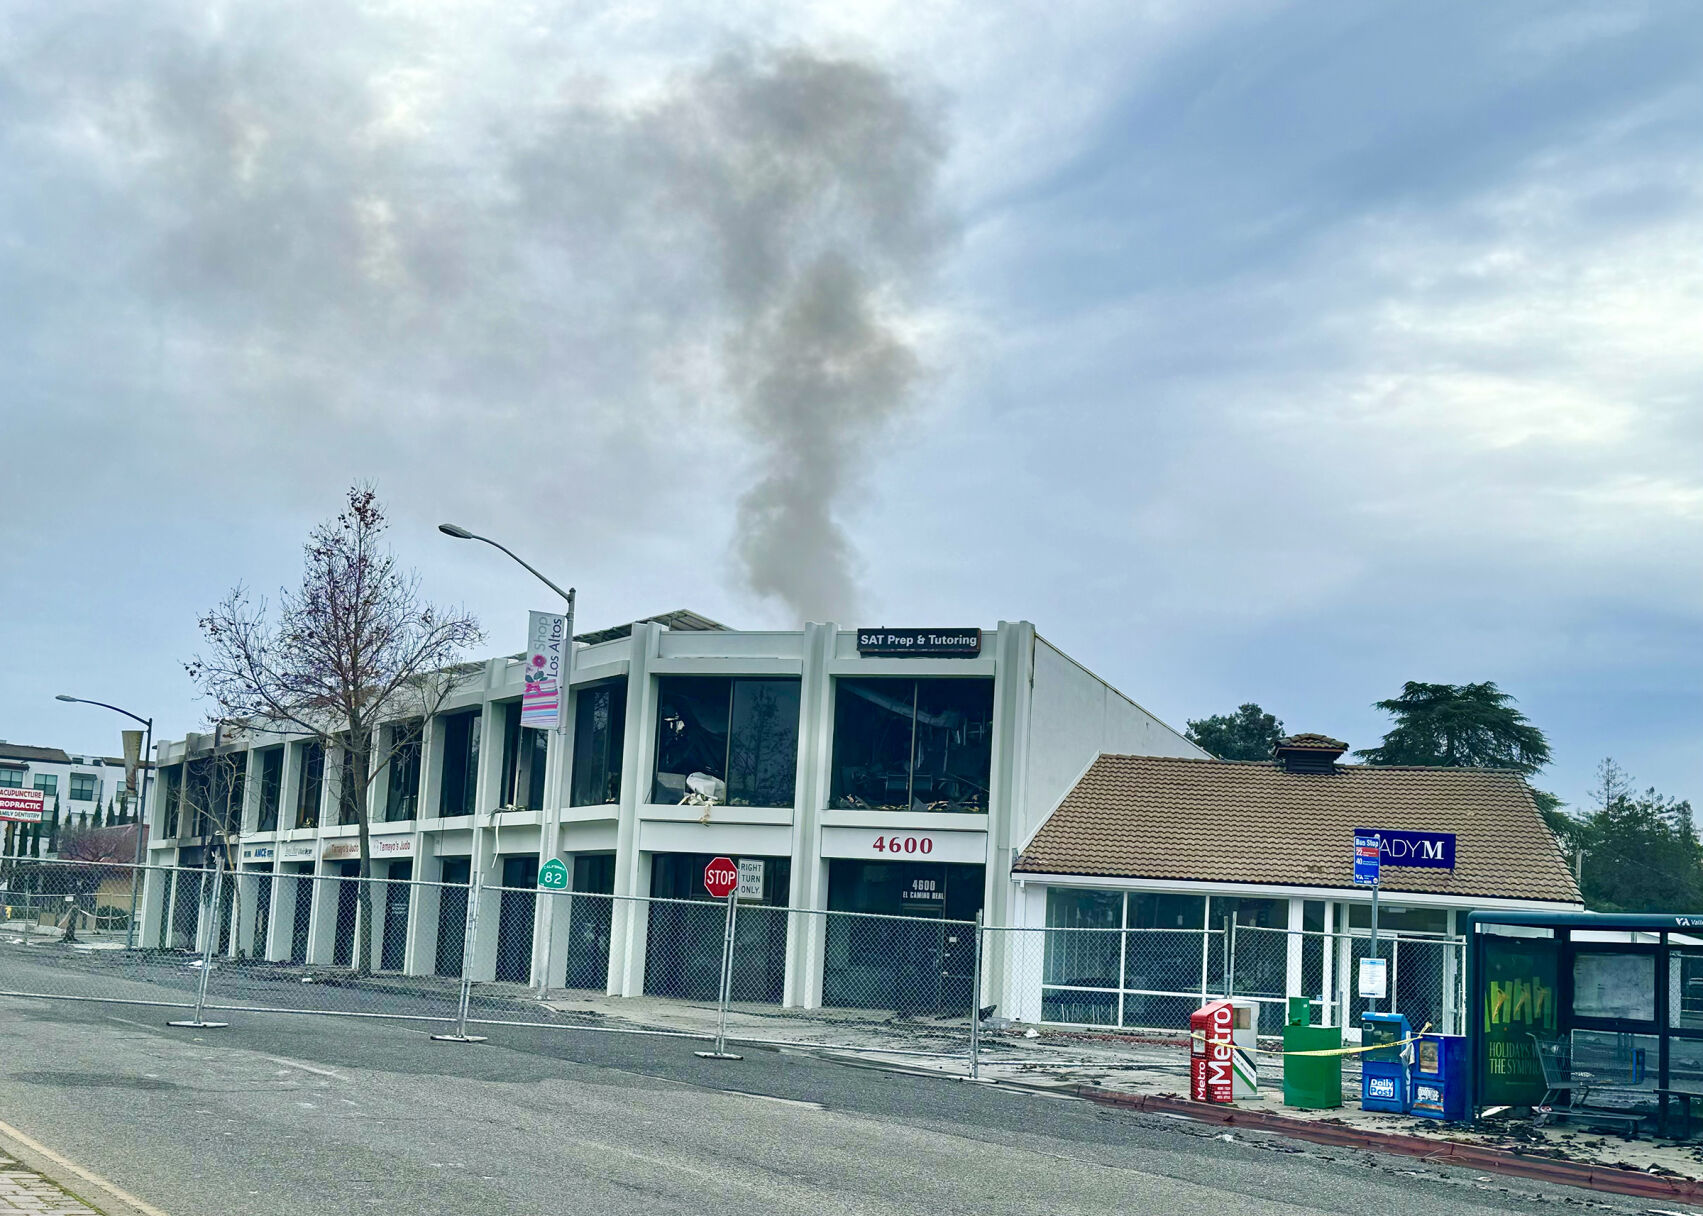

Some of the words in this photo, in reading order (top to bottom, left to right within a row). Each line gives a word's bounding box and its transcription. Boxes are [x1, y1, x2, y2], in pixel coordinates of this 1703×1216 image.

[533, 616, 551, 651] Shop
[548, 618, 562, 653] Altos
[860, 634, 885, 645] SAT
[887, 635, 914, 647] Prep
[917, 634, 926, 645] &
[928, 635, 977, 647] Tutoring
[547, 656, 559, 677] Los
[872, 836, 933, 854] 4600
[1366, 839, 1379, 848] Stop
[740, 863, 762, 872] RIGHT
[545, 871, 562, 885] 82
[707, 870, 736, 885] STOP
[741, 874, 760, 883] TURN
[912, 879, 936, 891] 4600
[931, 892, 944, 900] REAL
[1208, 1007, 1231, 1085] Metro
[1489, 1041, 1530, 1058] HOLIDAYS
[1489, 1058, 1506, 1074] THE
[1197, 1061, 1206, 1100] Metro
[1371, 1078, 1394, 1088] Daily
[1370, 1088, 1393, 1097] Post
